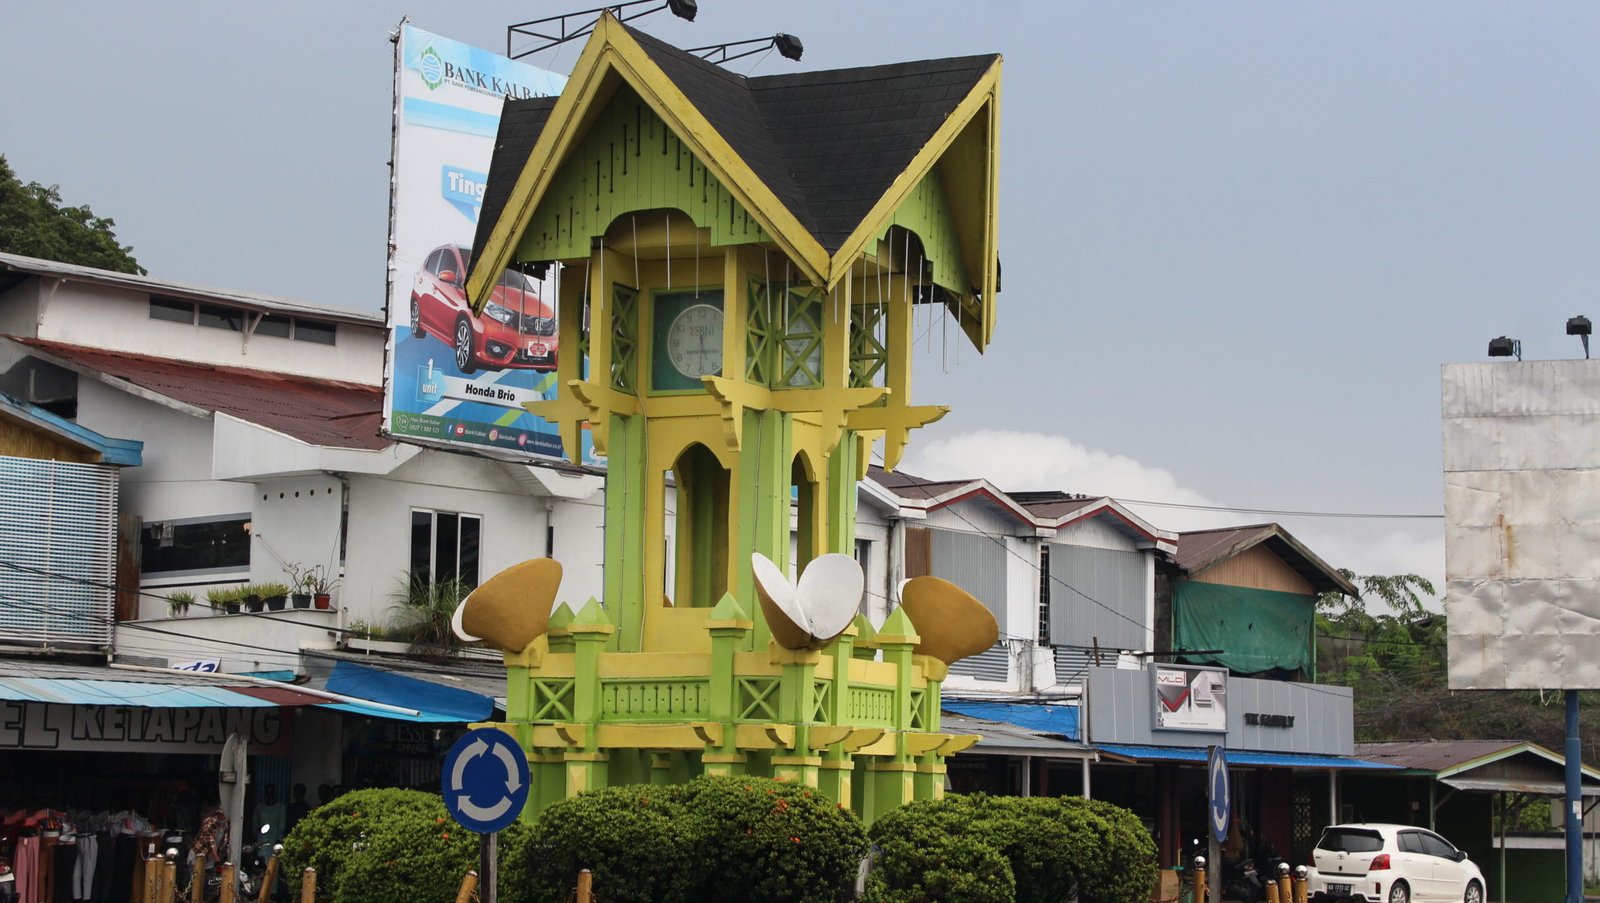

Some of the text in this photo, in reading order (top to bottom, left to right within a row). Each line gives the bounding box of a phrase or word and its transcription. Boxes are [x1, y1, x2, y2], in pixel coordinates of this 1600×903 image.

[444, 62, 487, 89] BANK
[427, 358, 434, 380] 1
[422, 382, 438, 394] unit
[465, 384, 515, 401] Honda Brio
[71, 704, 281, 745] KETAPANG
